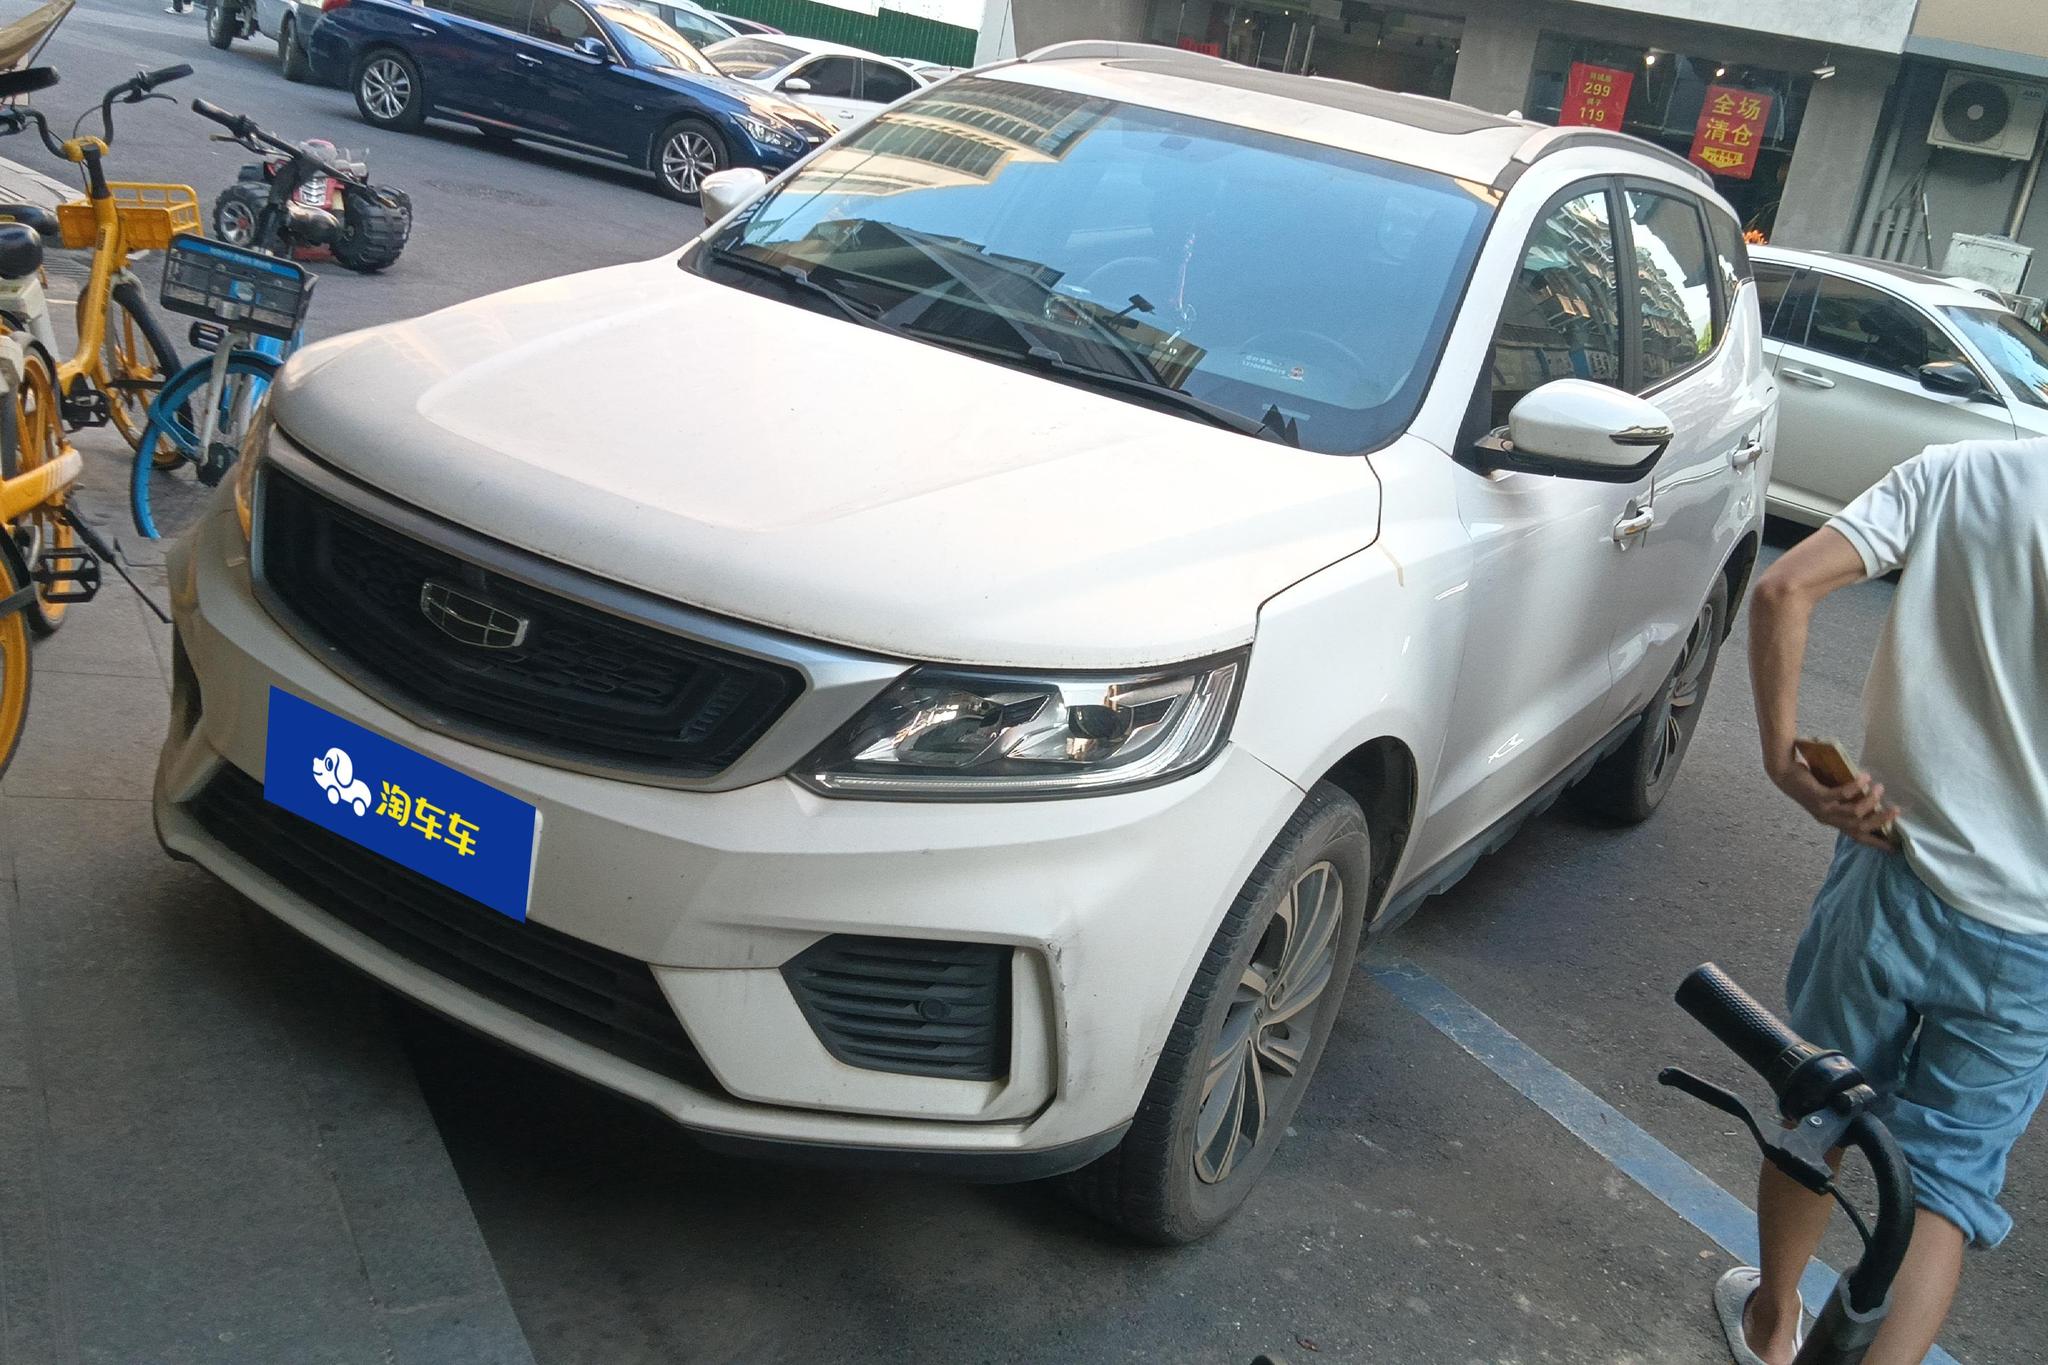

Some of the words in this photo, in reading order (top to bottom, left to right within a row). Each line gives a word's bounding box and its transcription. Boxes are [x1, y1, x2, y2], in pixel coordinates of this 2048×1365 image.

[1584, 82, 1611, 97] 299
[1580, 106, 1605, 122] 119
[1712, 93, 1761, 120] 全场
[1704, 118, 1753, 146] 清仓
